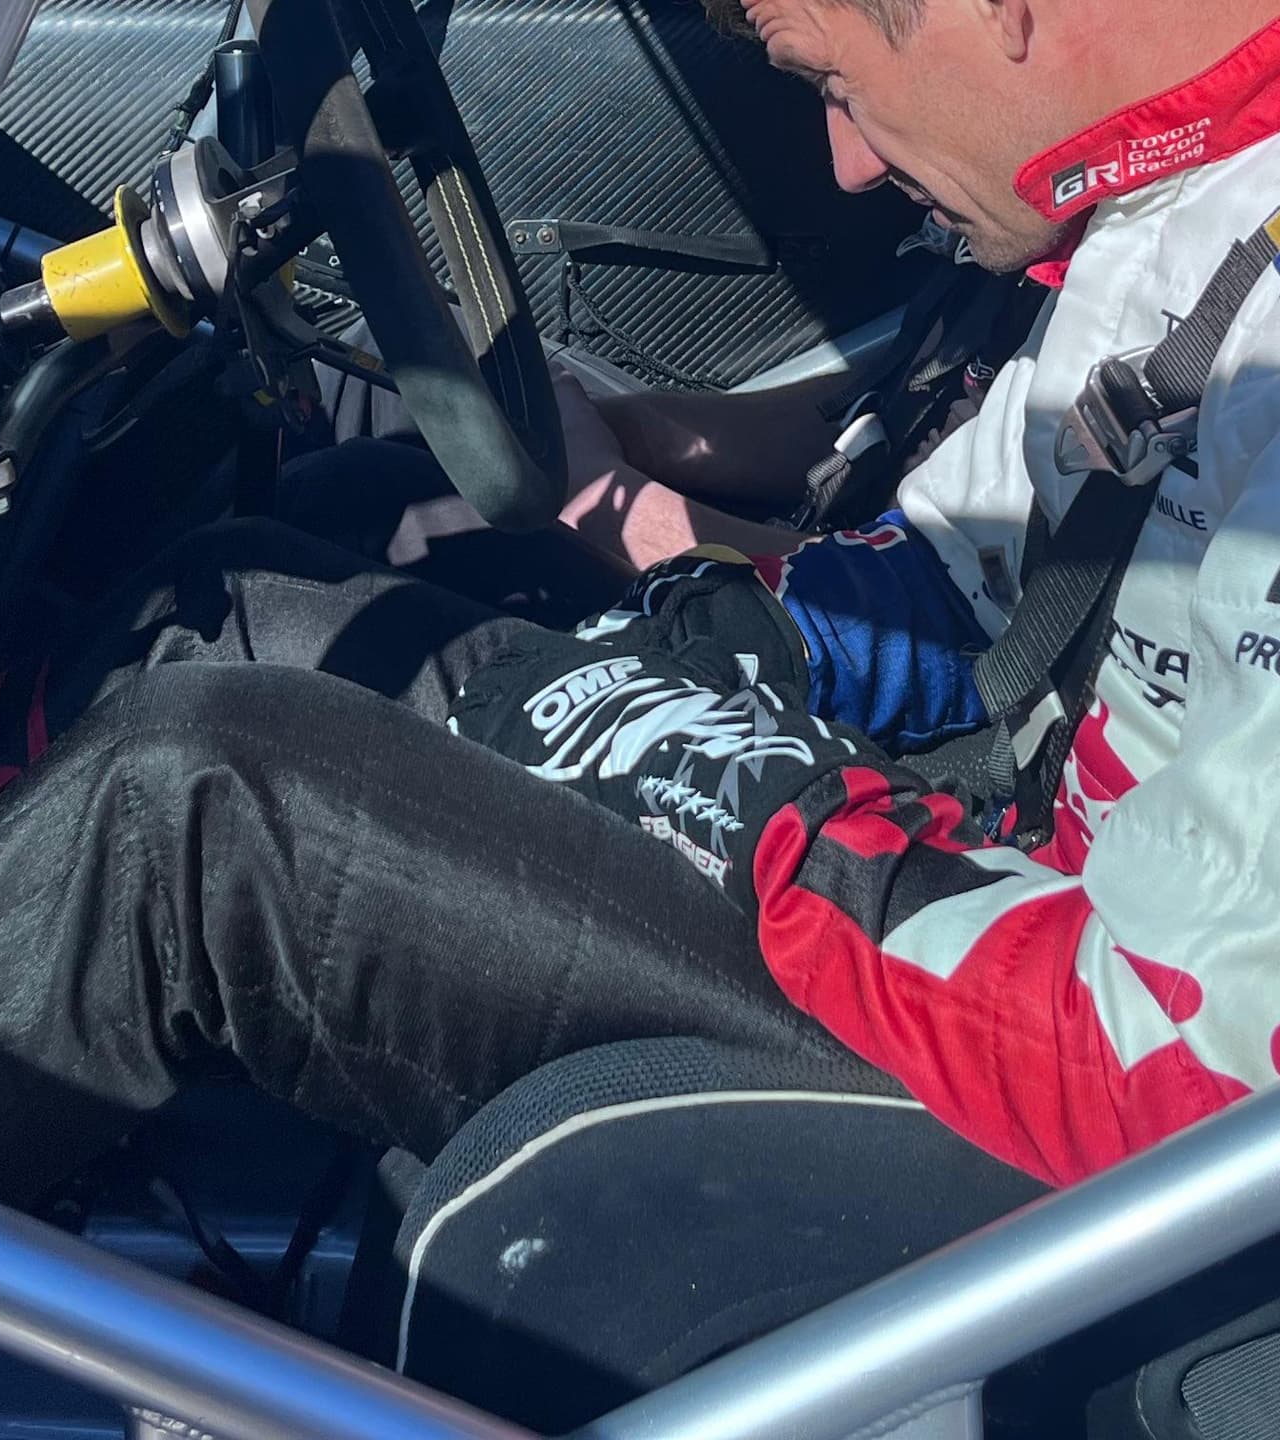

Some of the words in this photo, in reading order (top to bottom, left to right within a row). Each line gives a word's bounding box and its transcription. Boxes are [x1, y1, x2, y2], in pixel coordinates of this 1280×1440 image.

[1126, 117, 1211, 150] TOYOTA
[1127, 131, 1205, 162] GAZOO
[1128, 143, 1204, 176] Racing
[1054, 160, 1121, 206] GR
[528, 658, 645, 734] OMP
